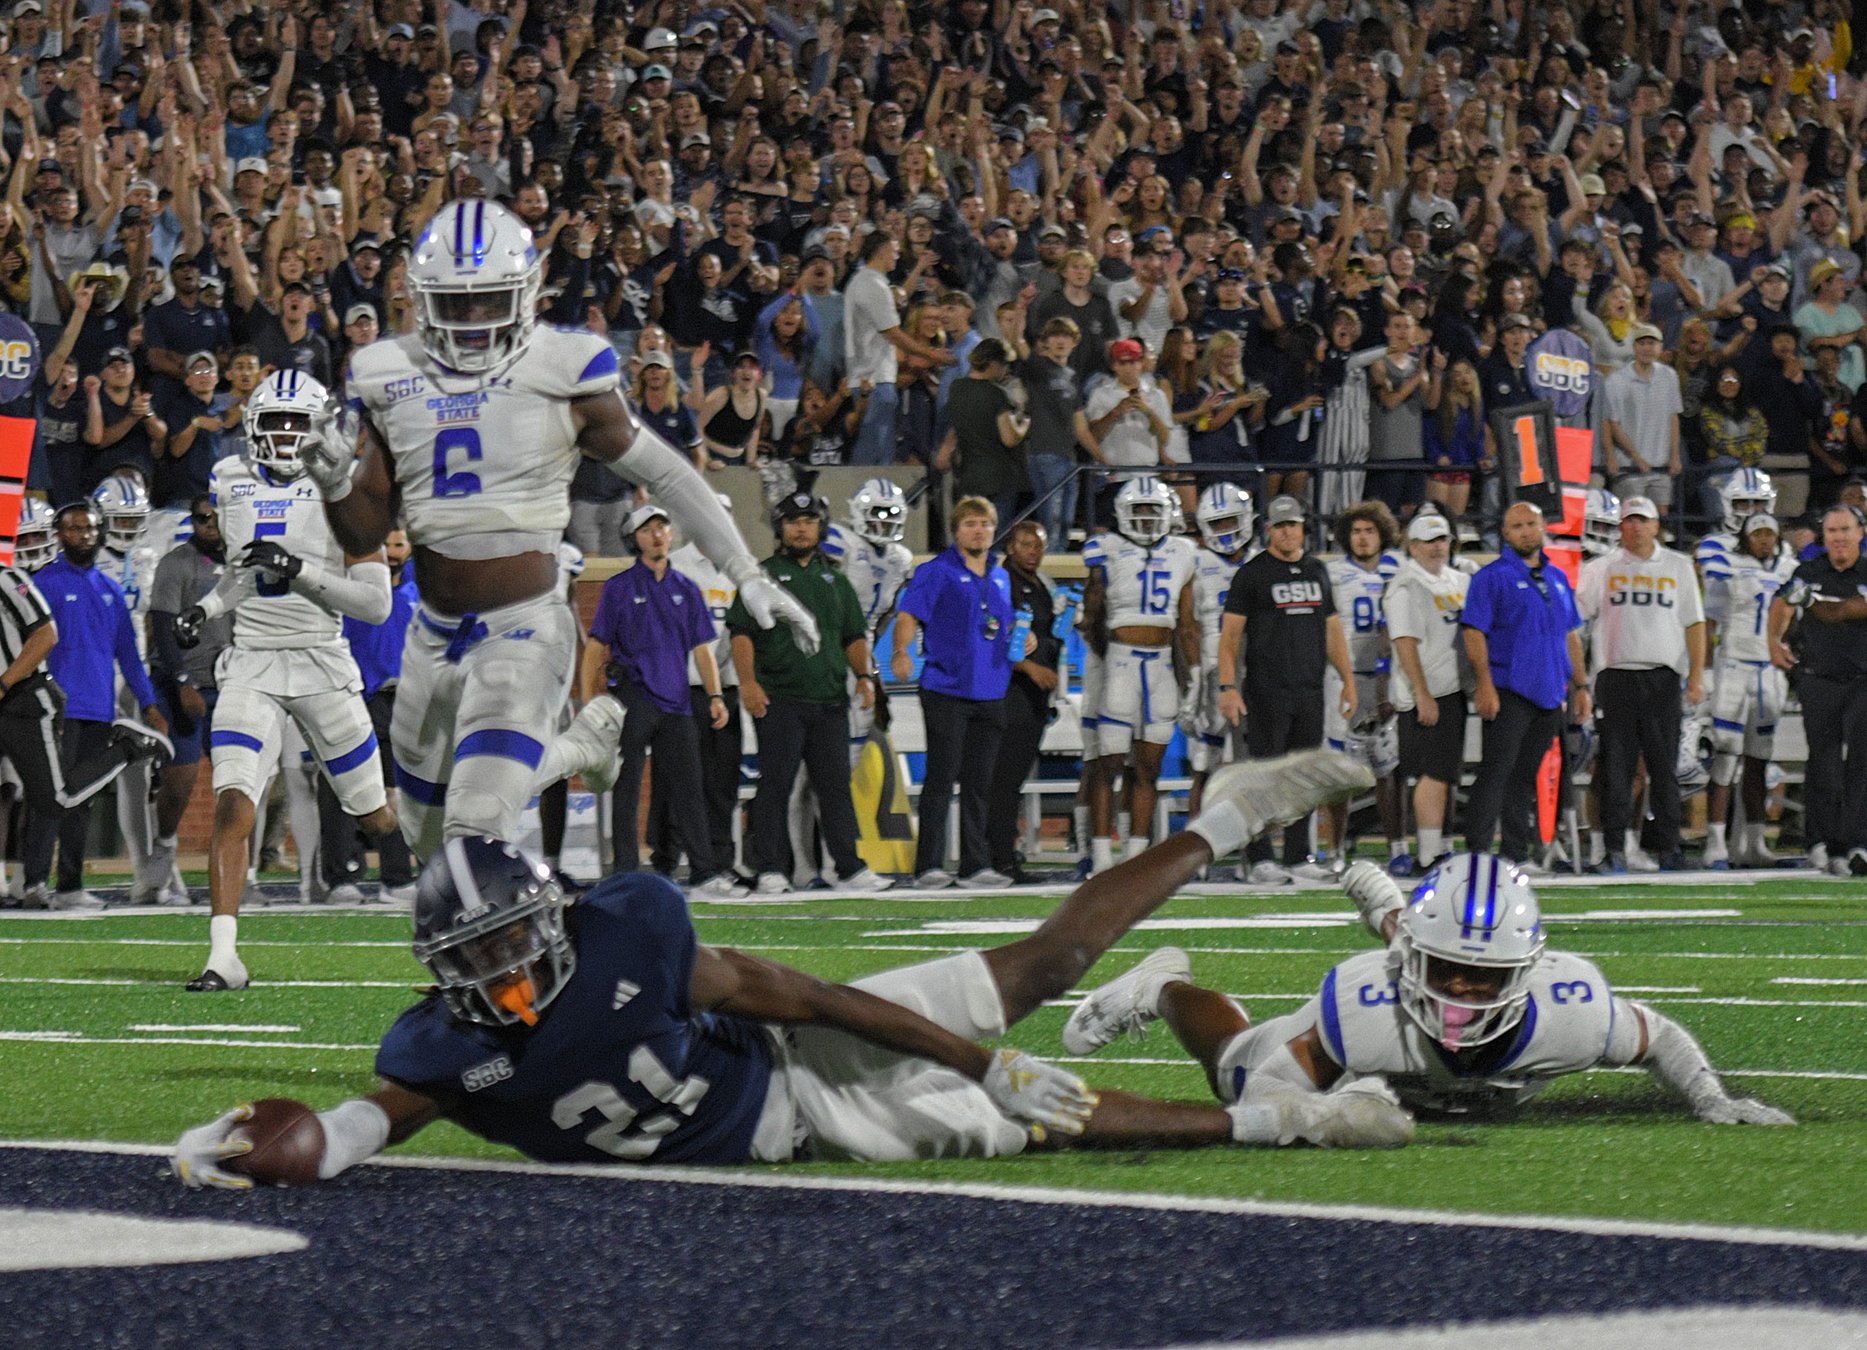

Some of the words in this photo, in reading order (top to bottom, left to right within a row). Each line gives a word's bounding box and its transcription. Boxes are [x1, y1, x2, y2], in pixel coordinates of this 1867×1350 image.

[384, 376, 425, 402] SBC
[1536, 353, 1590, 394] SBC
[426, 392, 489, 410] GEORGIA
[436, 407, 480, 421] STATE
[432, 427, 483, 500] 6
[1514, 415, 1544, 486] 1
[230, 484, 257, 498] SBC
[1136, 569, 1172, 615] 15
[1271, 580, 1323, 604] GSU
[1608, 575, 1677, 609] SBC
[1359, 980, 1400, 1008] 3
[1551, 980, 1593, 1005] 3
[461, 1056, 515, 1093] SBC
[551, 1044, 711, 1161] 21
